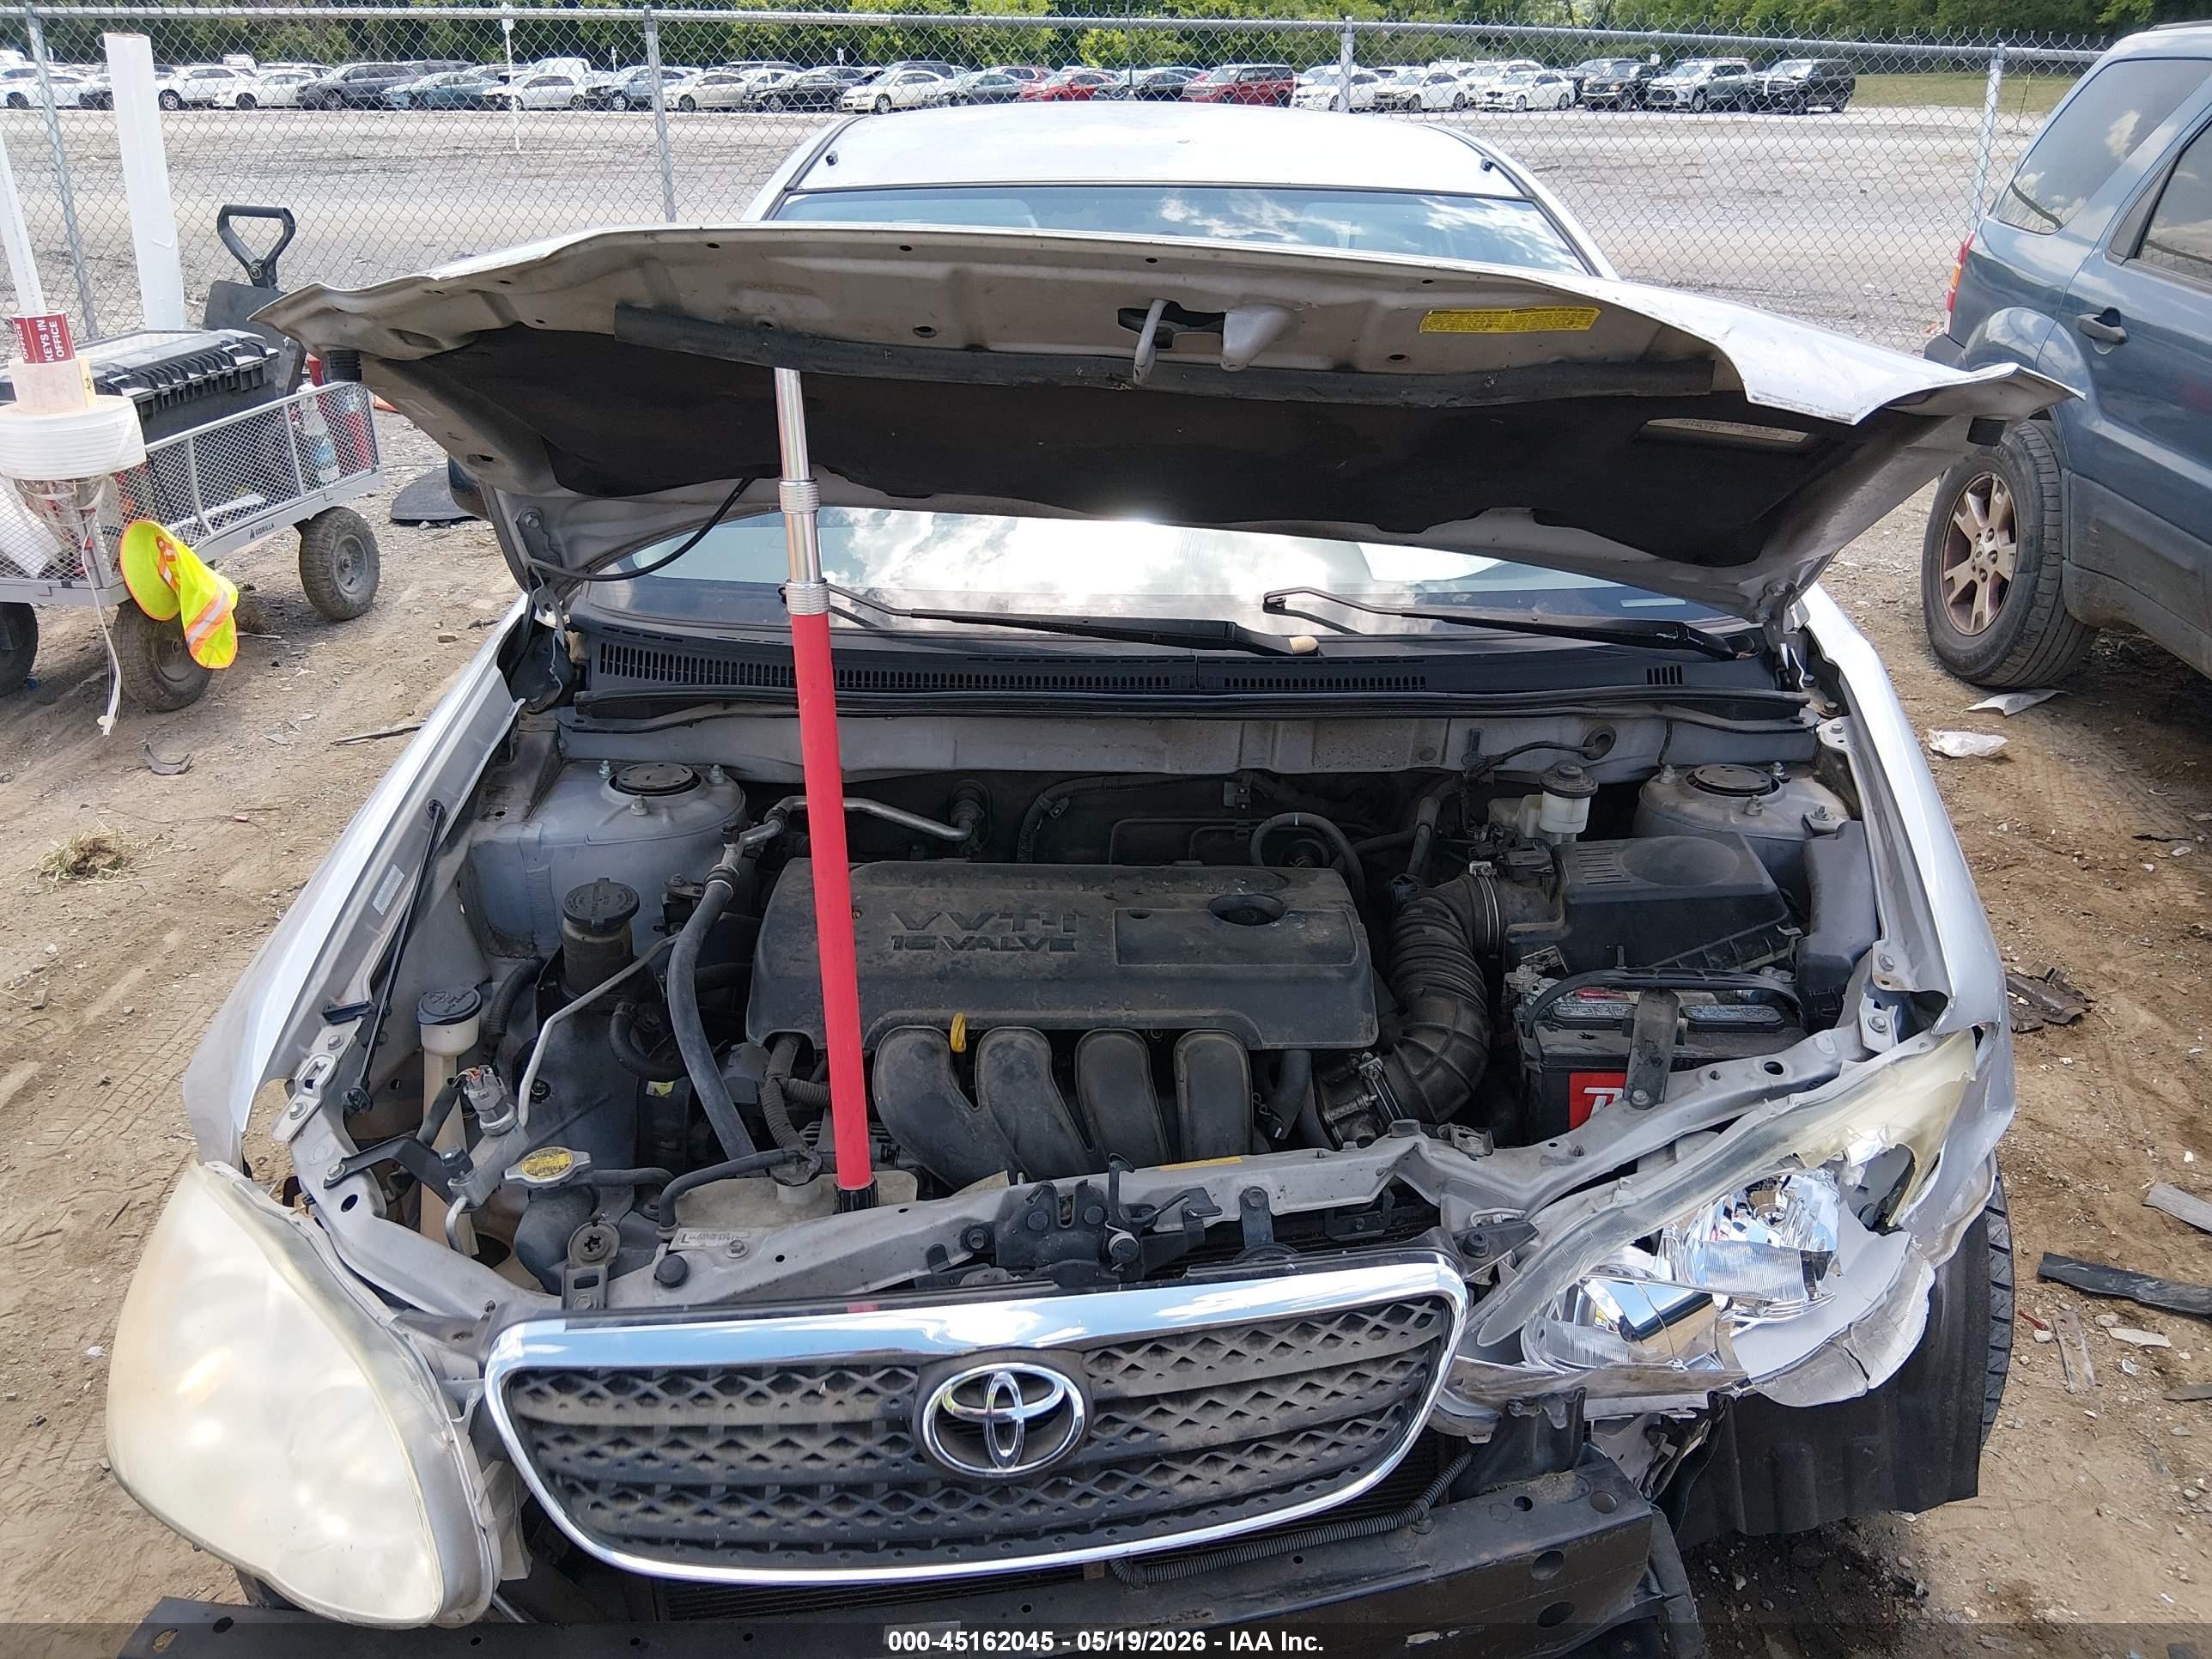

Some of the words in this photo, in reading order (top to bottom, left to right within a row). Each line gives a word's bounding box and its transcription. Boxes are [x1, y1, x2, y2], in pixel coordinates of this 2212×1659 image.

[36, 319, 48, 331] IN
[49, 320, 65, 358] OFFICE
[40, 333, 55, 362] KEYS
